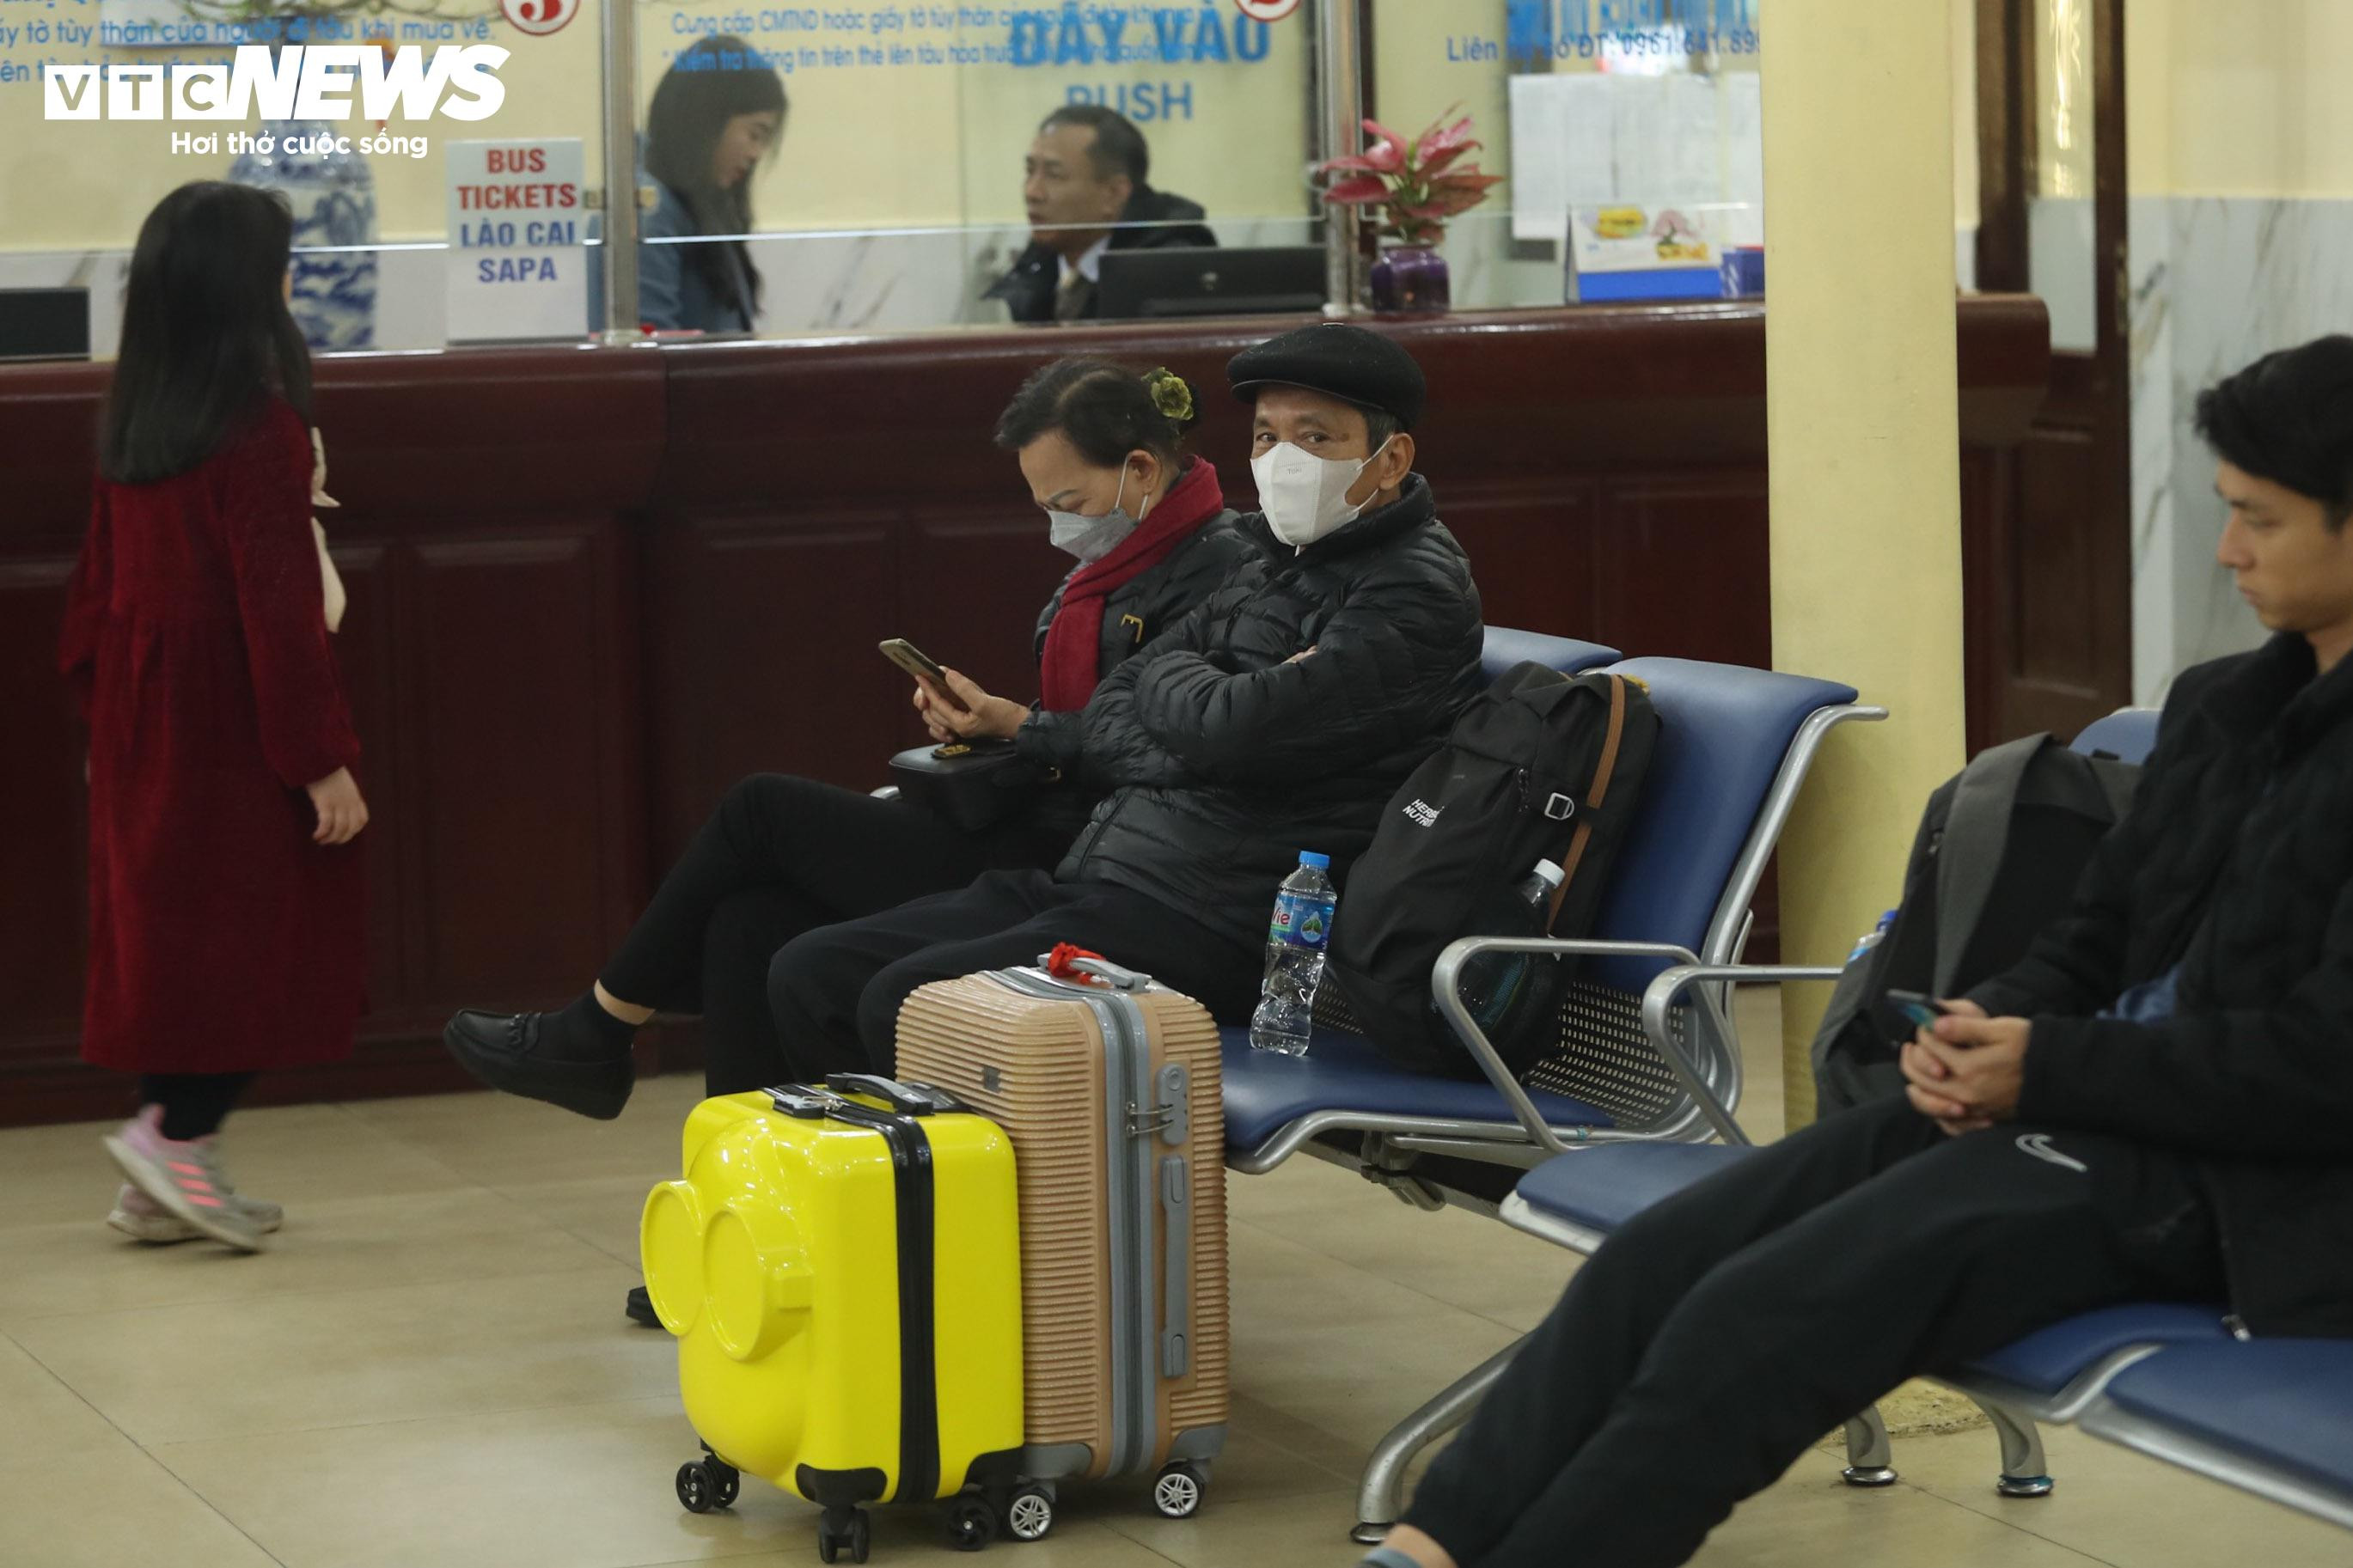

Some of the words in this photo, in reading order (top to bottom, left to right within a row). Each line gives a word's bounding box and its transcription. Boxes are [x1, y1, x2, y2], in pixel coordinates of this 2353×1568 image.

[27, 19, 50, 43] tờ
[57, 18, 93, 47] tùy
[101, 19, 153, 43] thân
[162, 15, 207, 43] của
[361, 16, 395, 40] khi
[402, 21, 455, 40] mua
[1447, 37, 1499, 62] Liên
[487, 148, 547, 174] BUS
[457, 183, 576, 210] TICKETS
[461, 217, 516, 247] LÀO
[527, 221, 575, 246] CAI
[479, 257, 557, 283] SAPA
